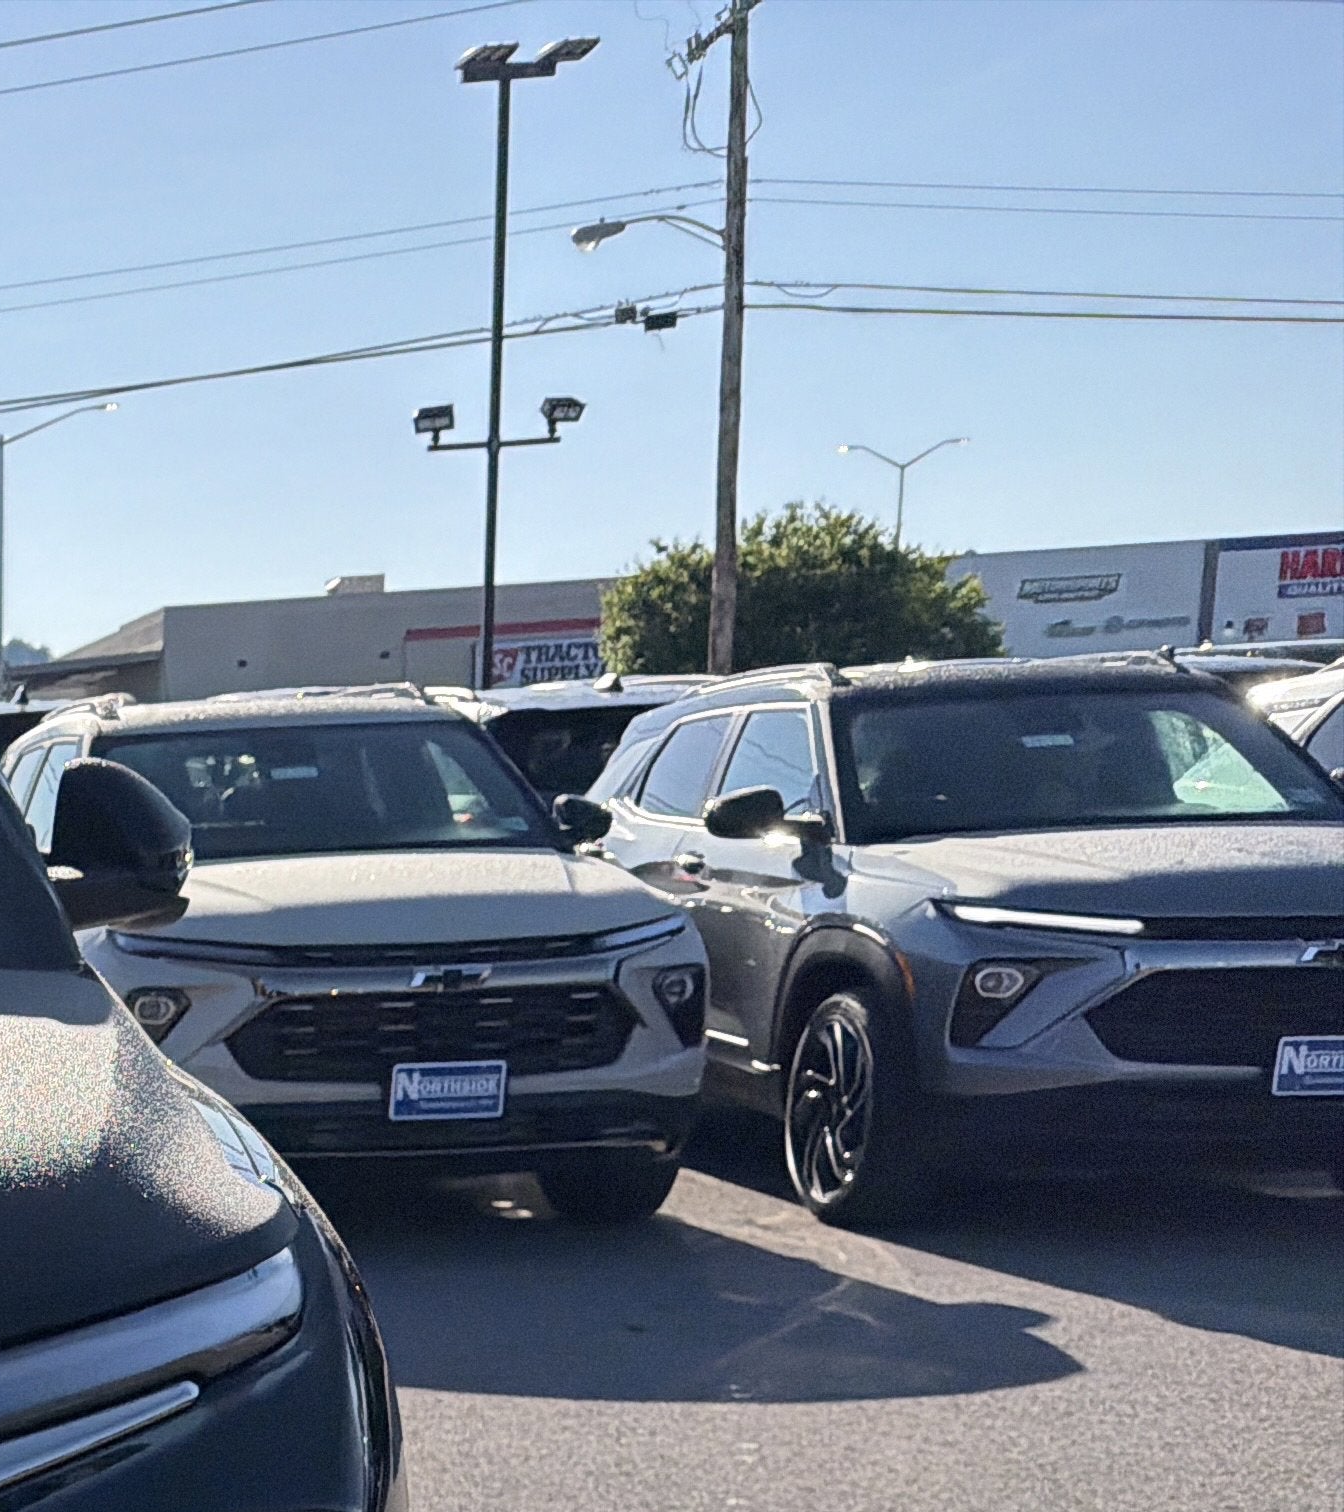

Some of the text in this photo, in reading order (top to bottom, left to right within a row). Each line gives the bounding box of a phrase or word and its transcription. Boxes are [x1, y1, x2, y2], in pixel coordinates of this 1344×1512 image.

[1279, 548, 1344, 580] HAR
[1286, 582, 1344, 596] QUALIT
[1280, 1045, 1344, 1075] NORT
[395, 1073, 499, 1101] NORTHSIDE
